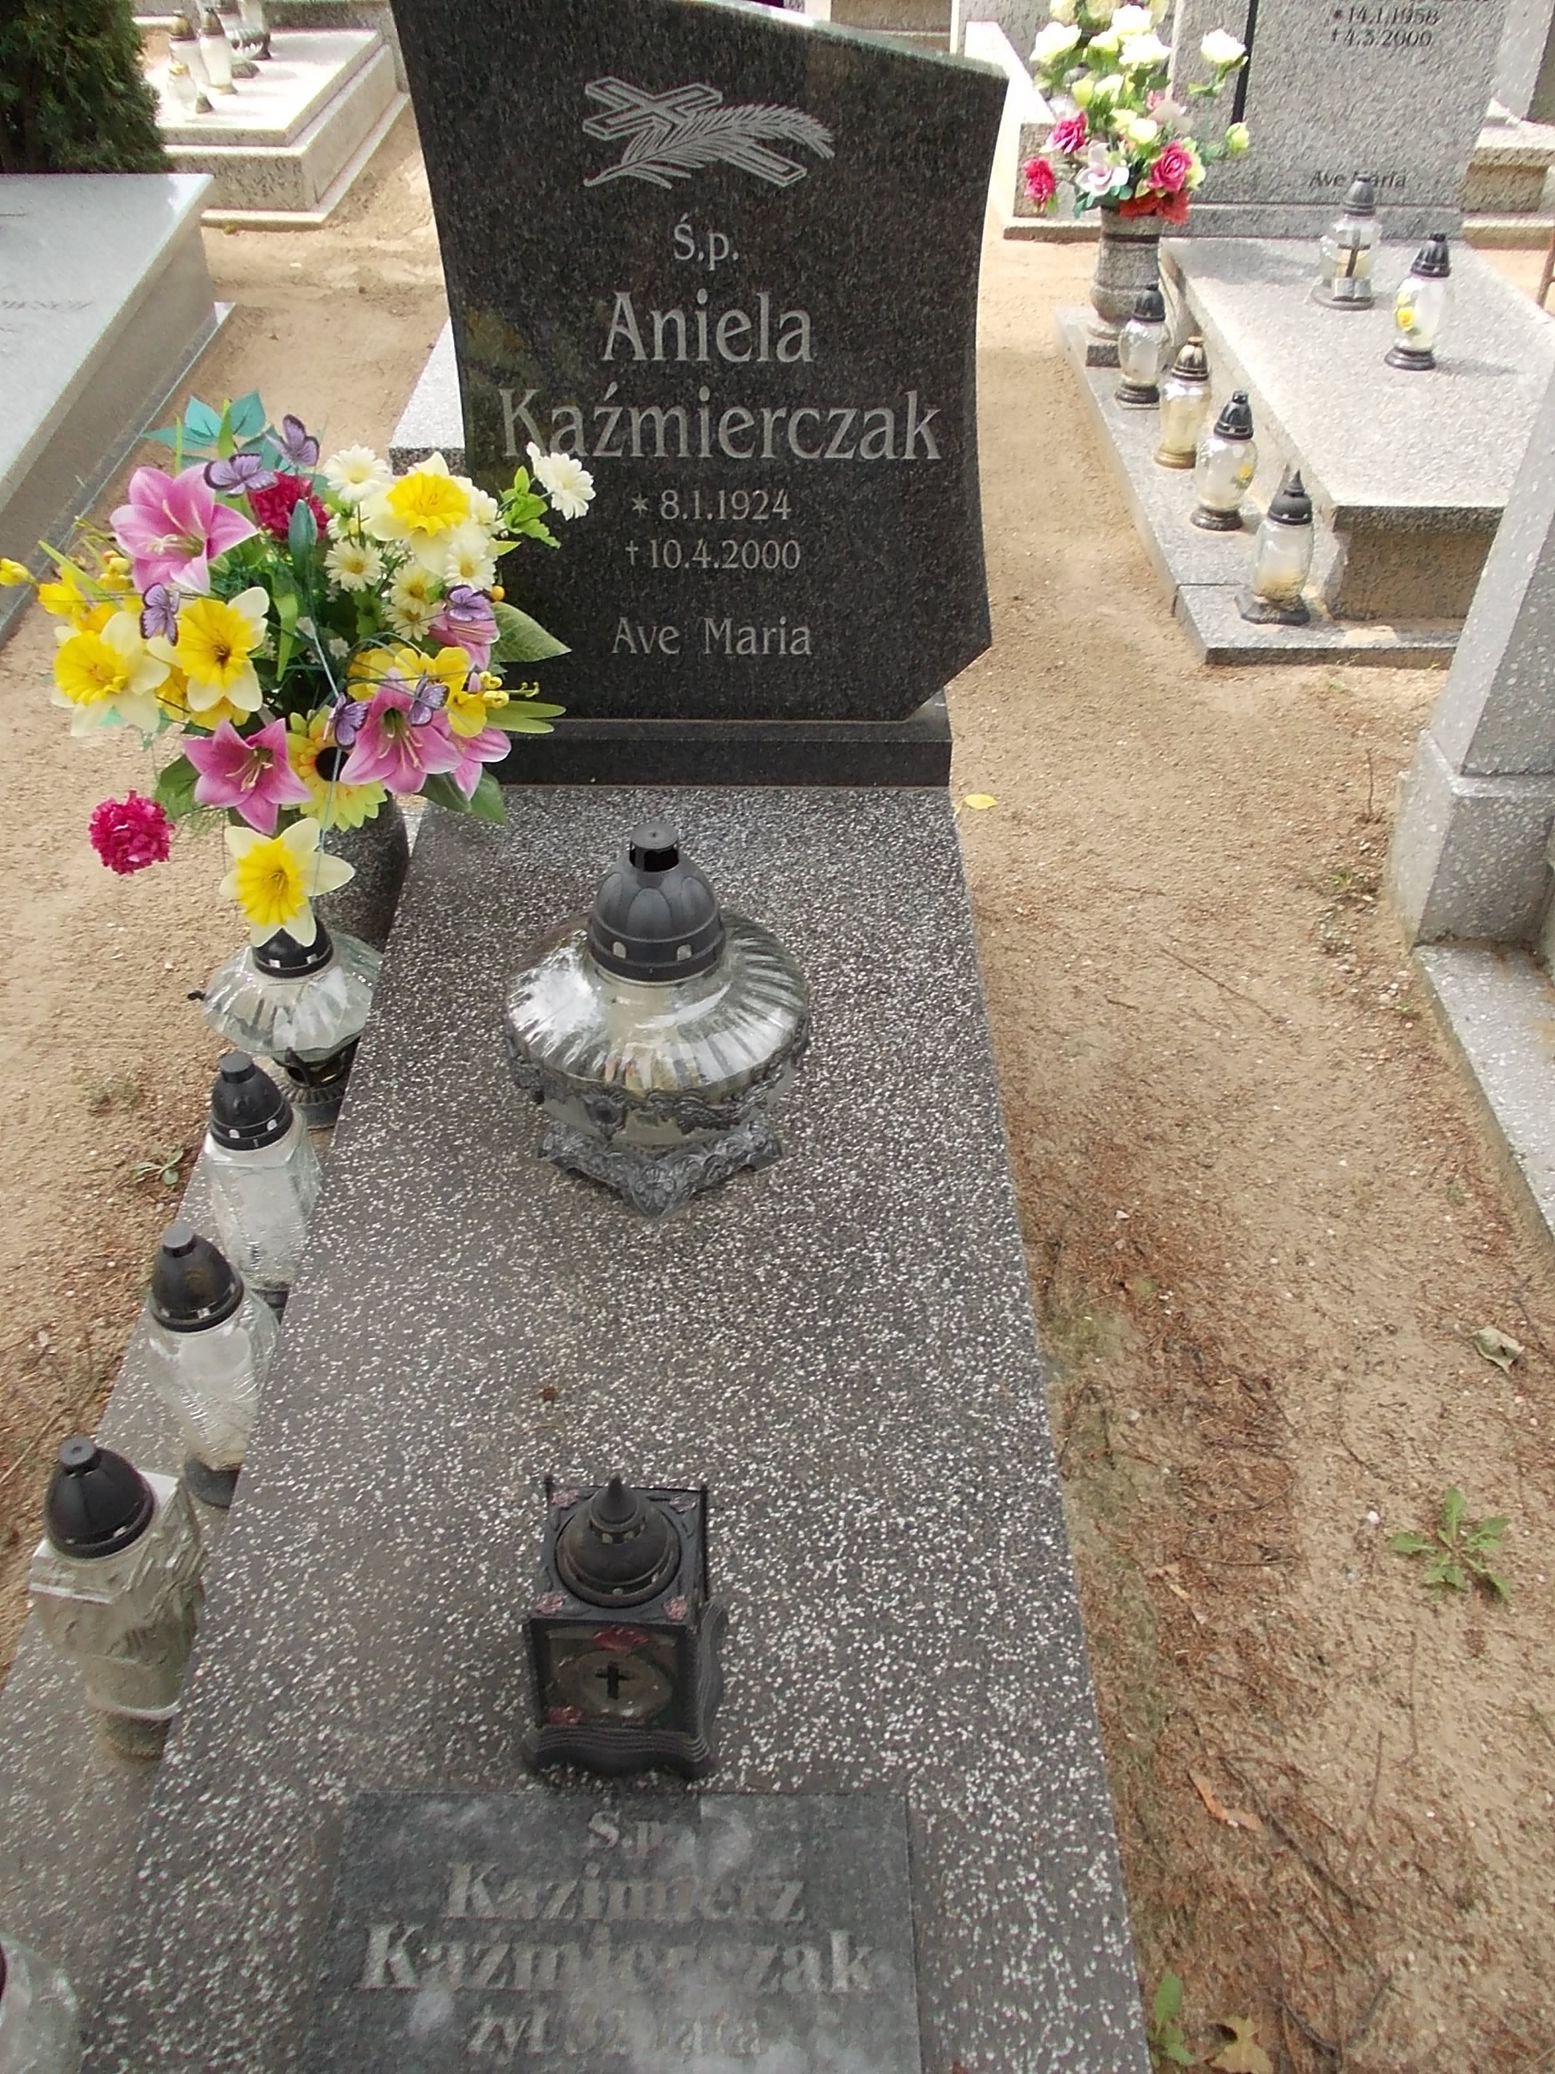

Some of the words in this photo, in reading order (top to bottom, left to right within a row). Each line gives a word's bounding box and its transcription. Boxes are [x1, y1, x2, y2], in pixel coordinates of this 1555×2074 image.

[1309, 170, 1344, 187] Ave
[673, 214, 740, 270] Ś.p.
[602, 288, 815, 363] Aniela
[498, 381, 942, 461] Kaźmierczak
[612, 616, 682, 655] Ave
[703, 617, 813, 656] Maria
